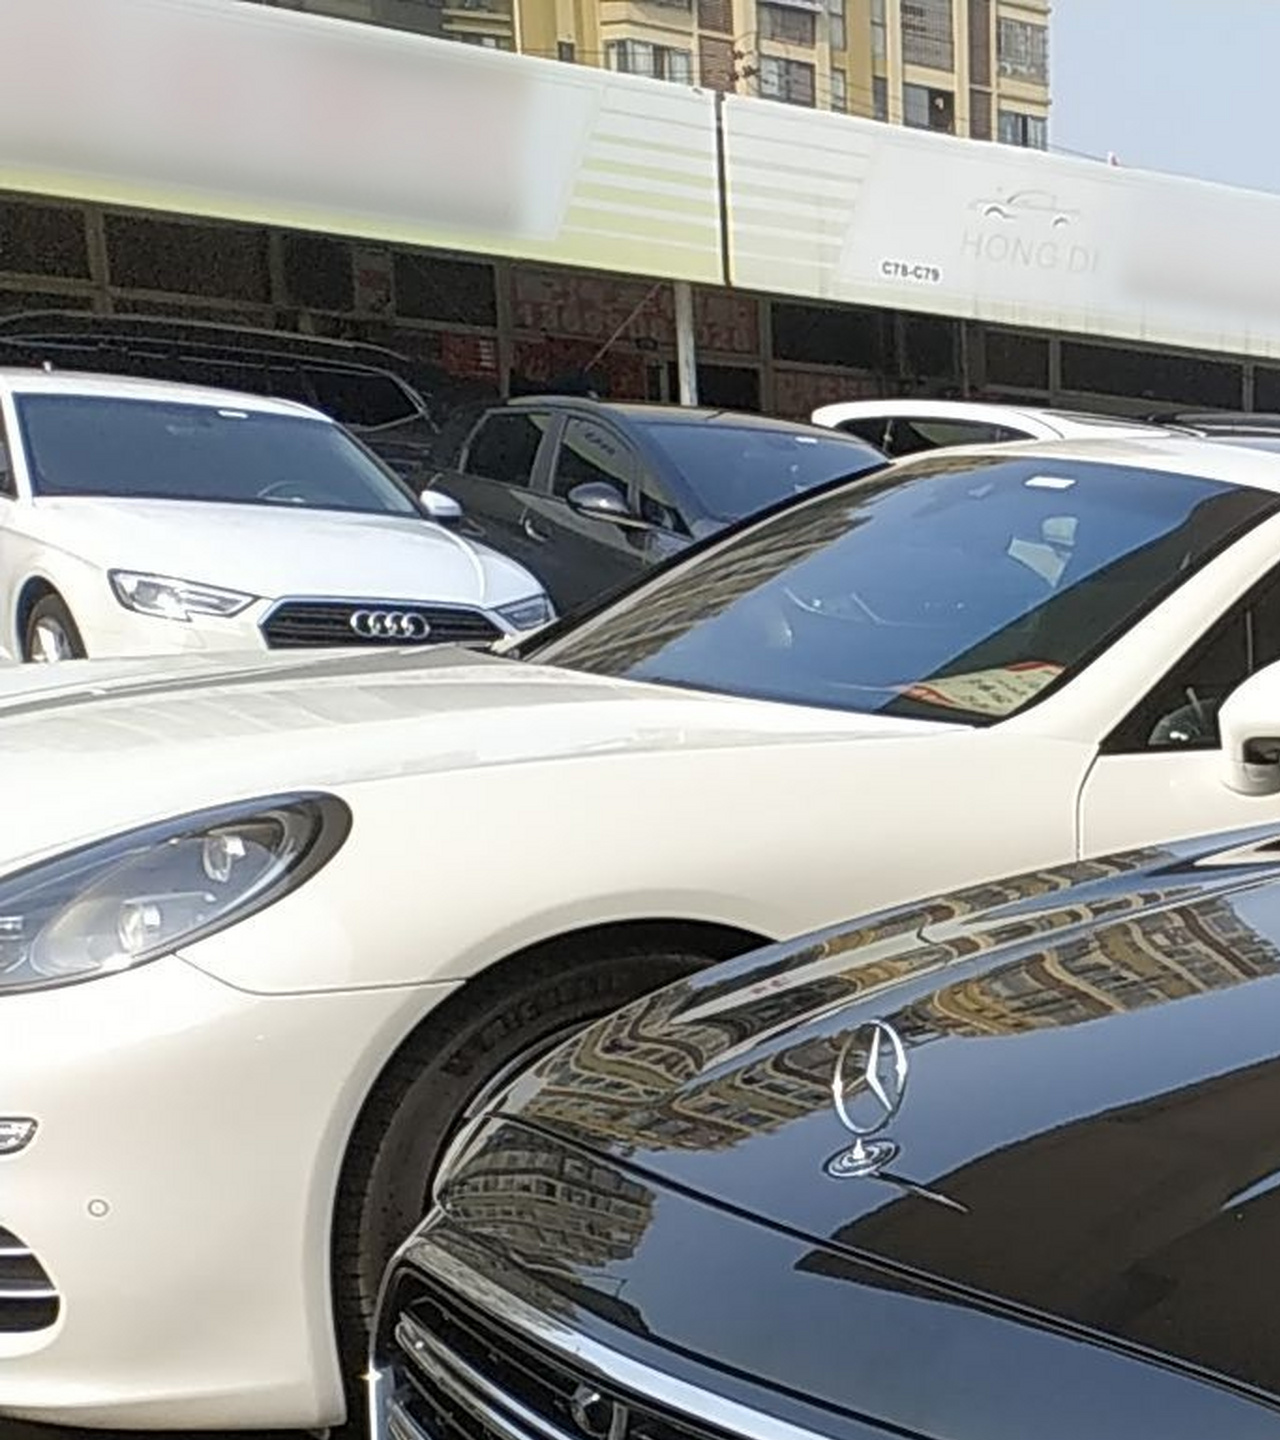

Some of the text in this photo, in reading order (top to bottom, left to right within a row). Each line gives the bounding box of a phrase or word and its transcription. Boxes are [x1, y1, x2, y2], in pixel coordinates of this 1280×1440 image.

[961, 229, 1100, 273] HONG DI
[881, 260, 940, 282] C78-C79
